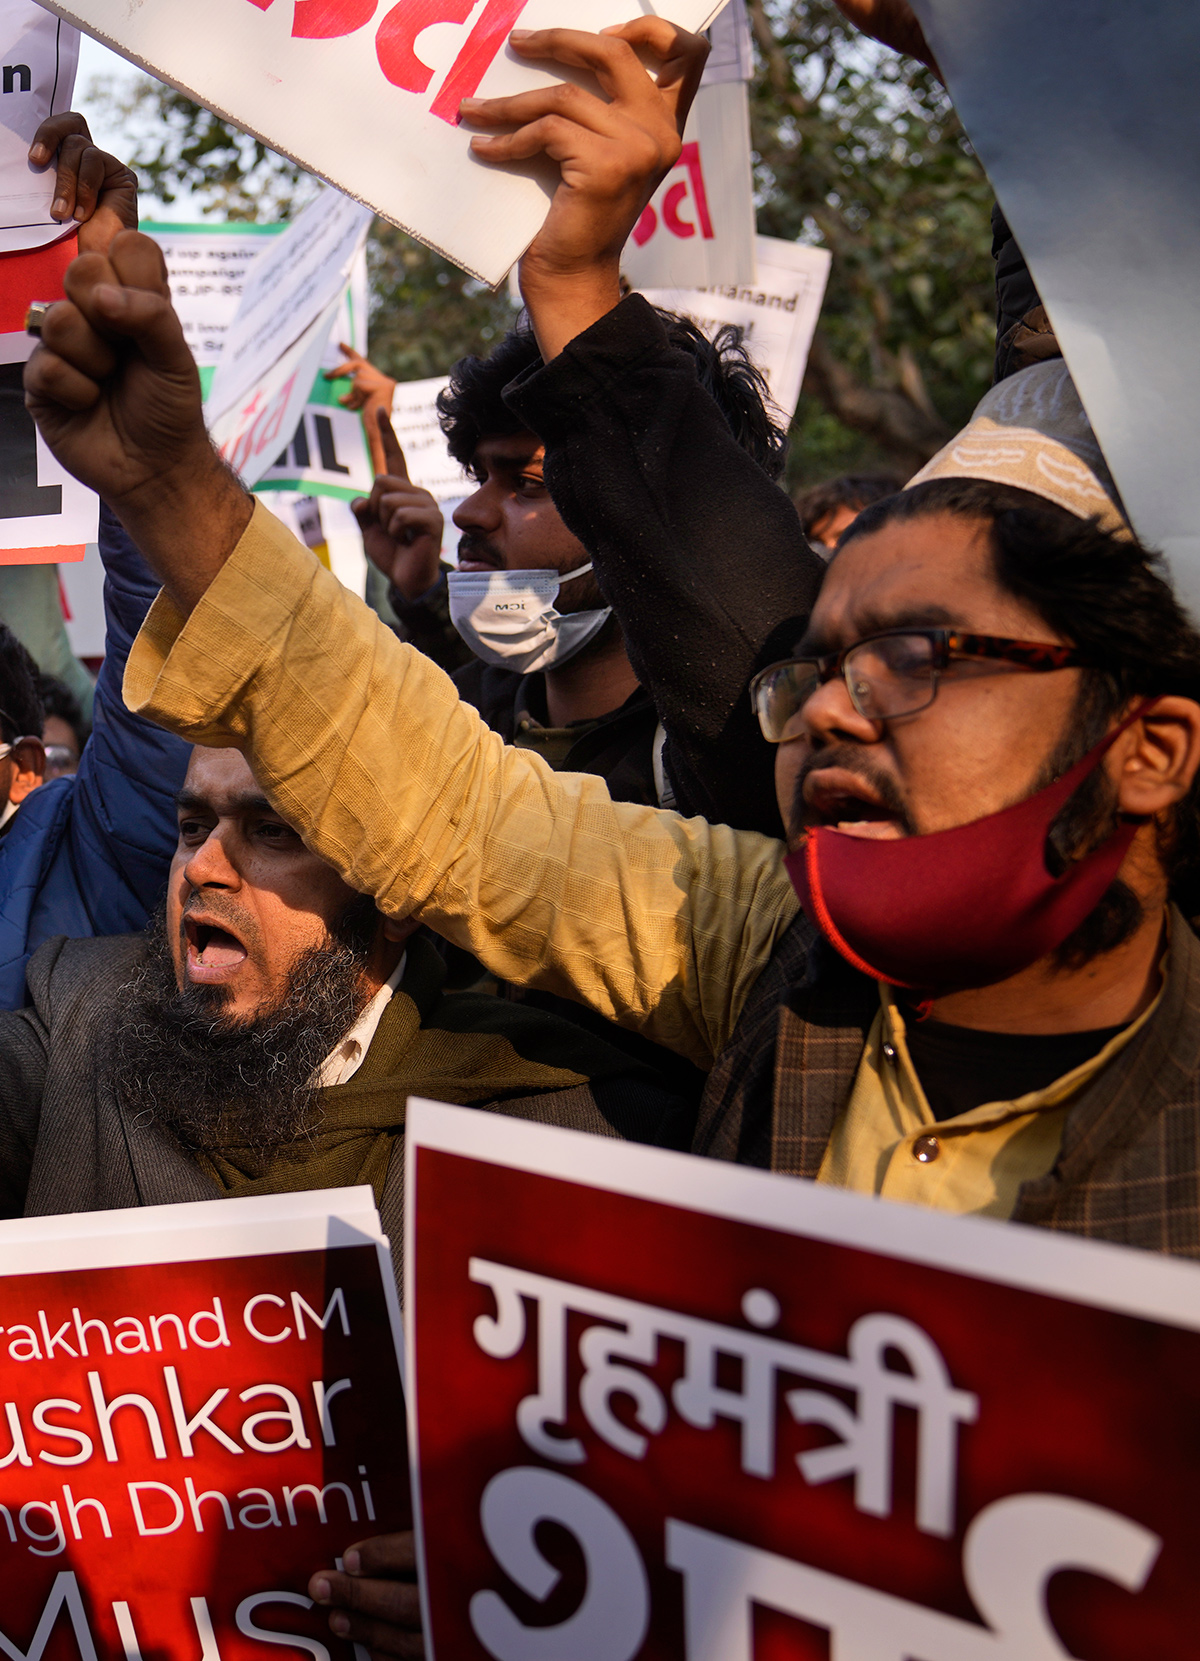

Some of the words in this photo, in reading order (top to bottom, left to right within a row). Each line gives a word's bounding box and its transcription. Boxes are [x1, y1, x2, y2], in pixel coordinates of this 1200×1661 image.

[243, 1286, 352, 1343] CM
[468, 1256, 979, 1540] गृहमंत्री
[127, 1464, 377, 1538] Dhami
